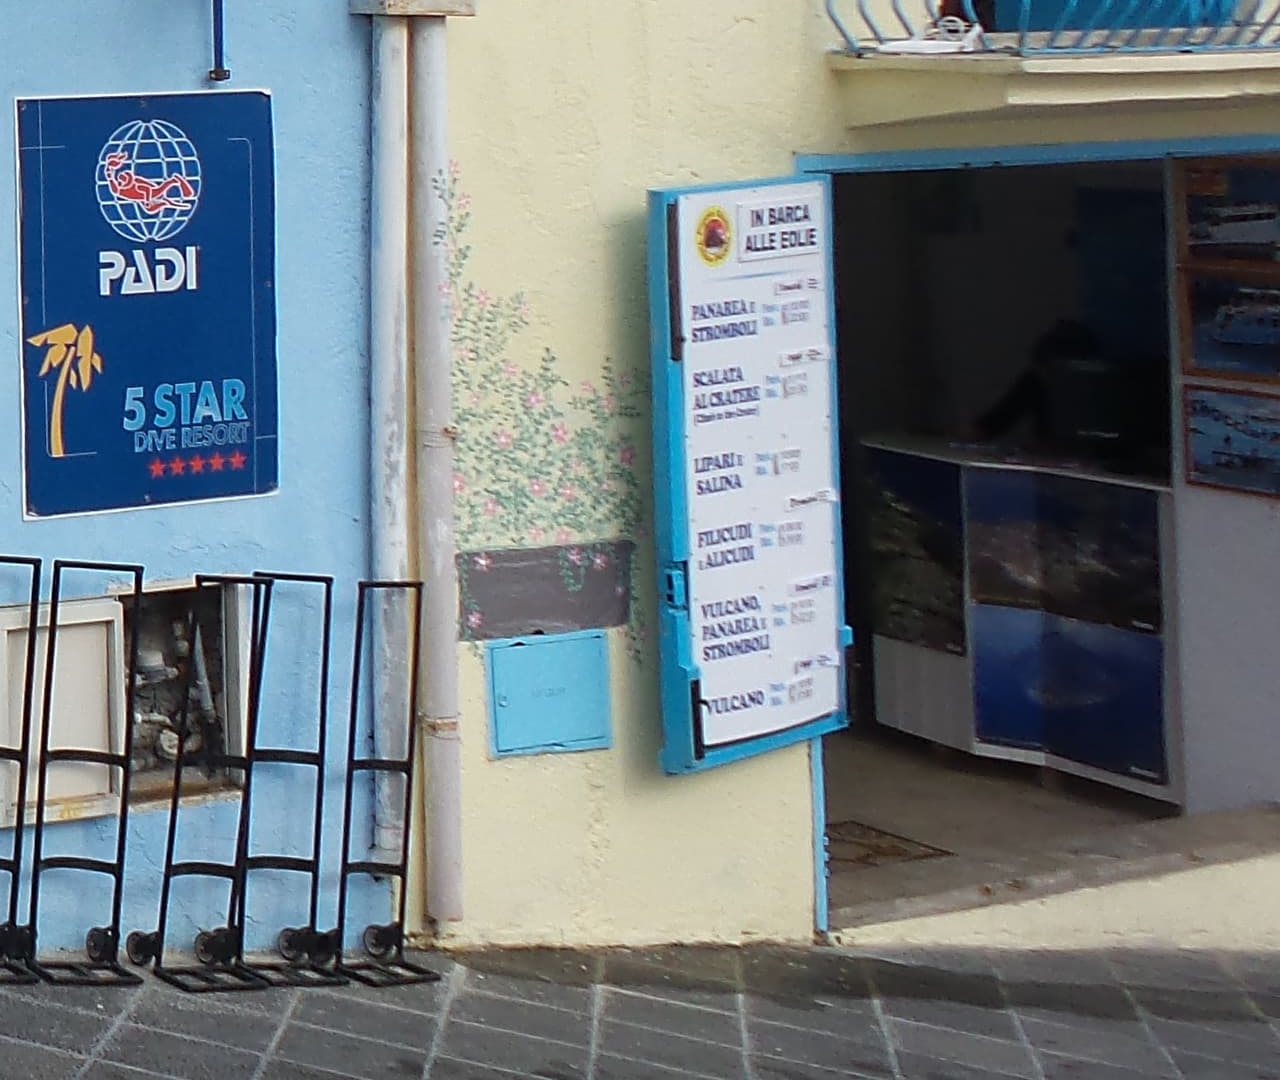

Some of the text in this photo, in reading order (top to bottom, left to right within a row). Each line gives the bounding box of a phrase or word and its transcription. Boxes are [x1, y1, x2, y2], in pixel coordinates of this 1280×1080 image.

[750, 204, 811, 228] IN BARCA
[745, 228, 817, 252] ALLE EOLIE
[99, 246, 198, 296] PADI
[123, 378, 248, 431] 5 STAR
[134, 421, 250, 453] DIVE RESORT
[696, 474, 742, 496] SALINA
[697, 523, 752, 548] FILICUDI
